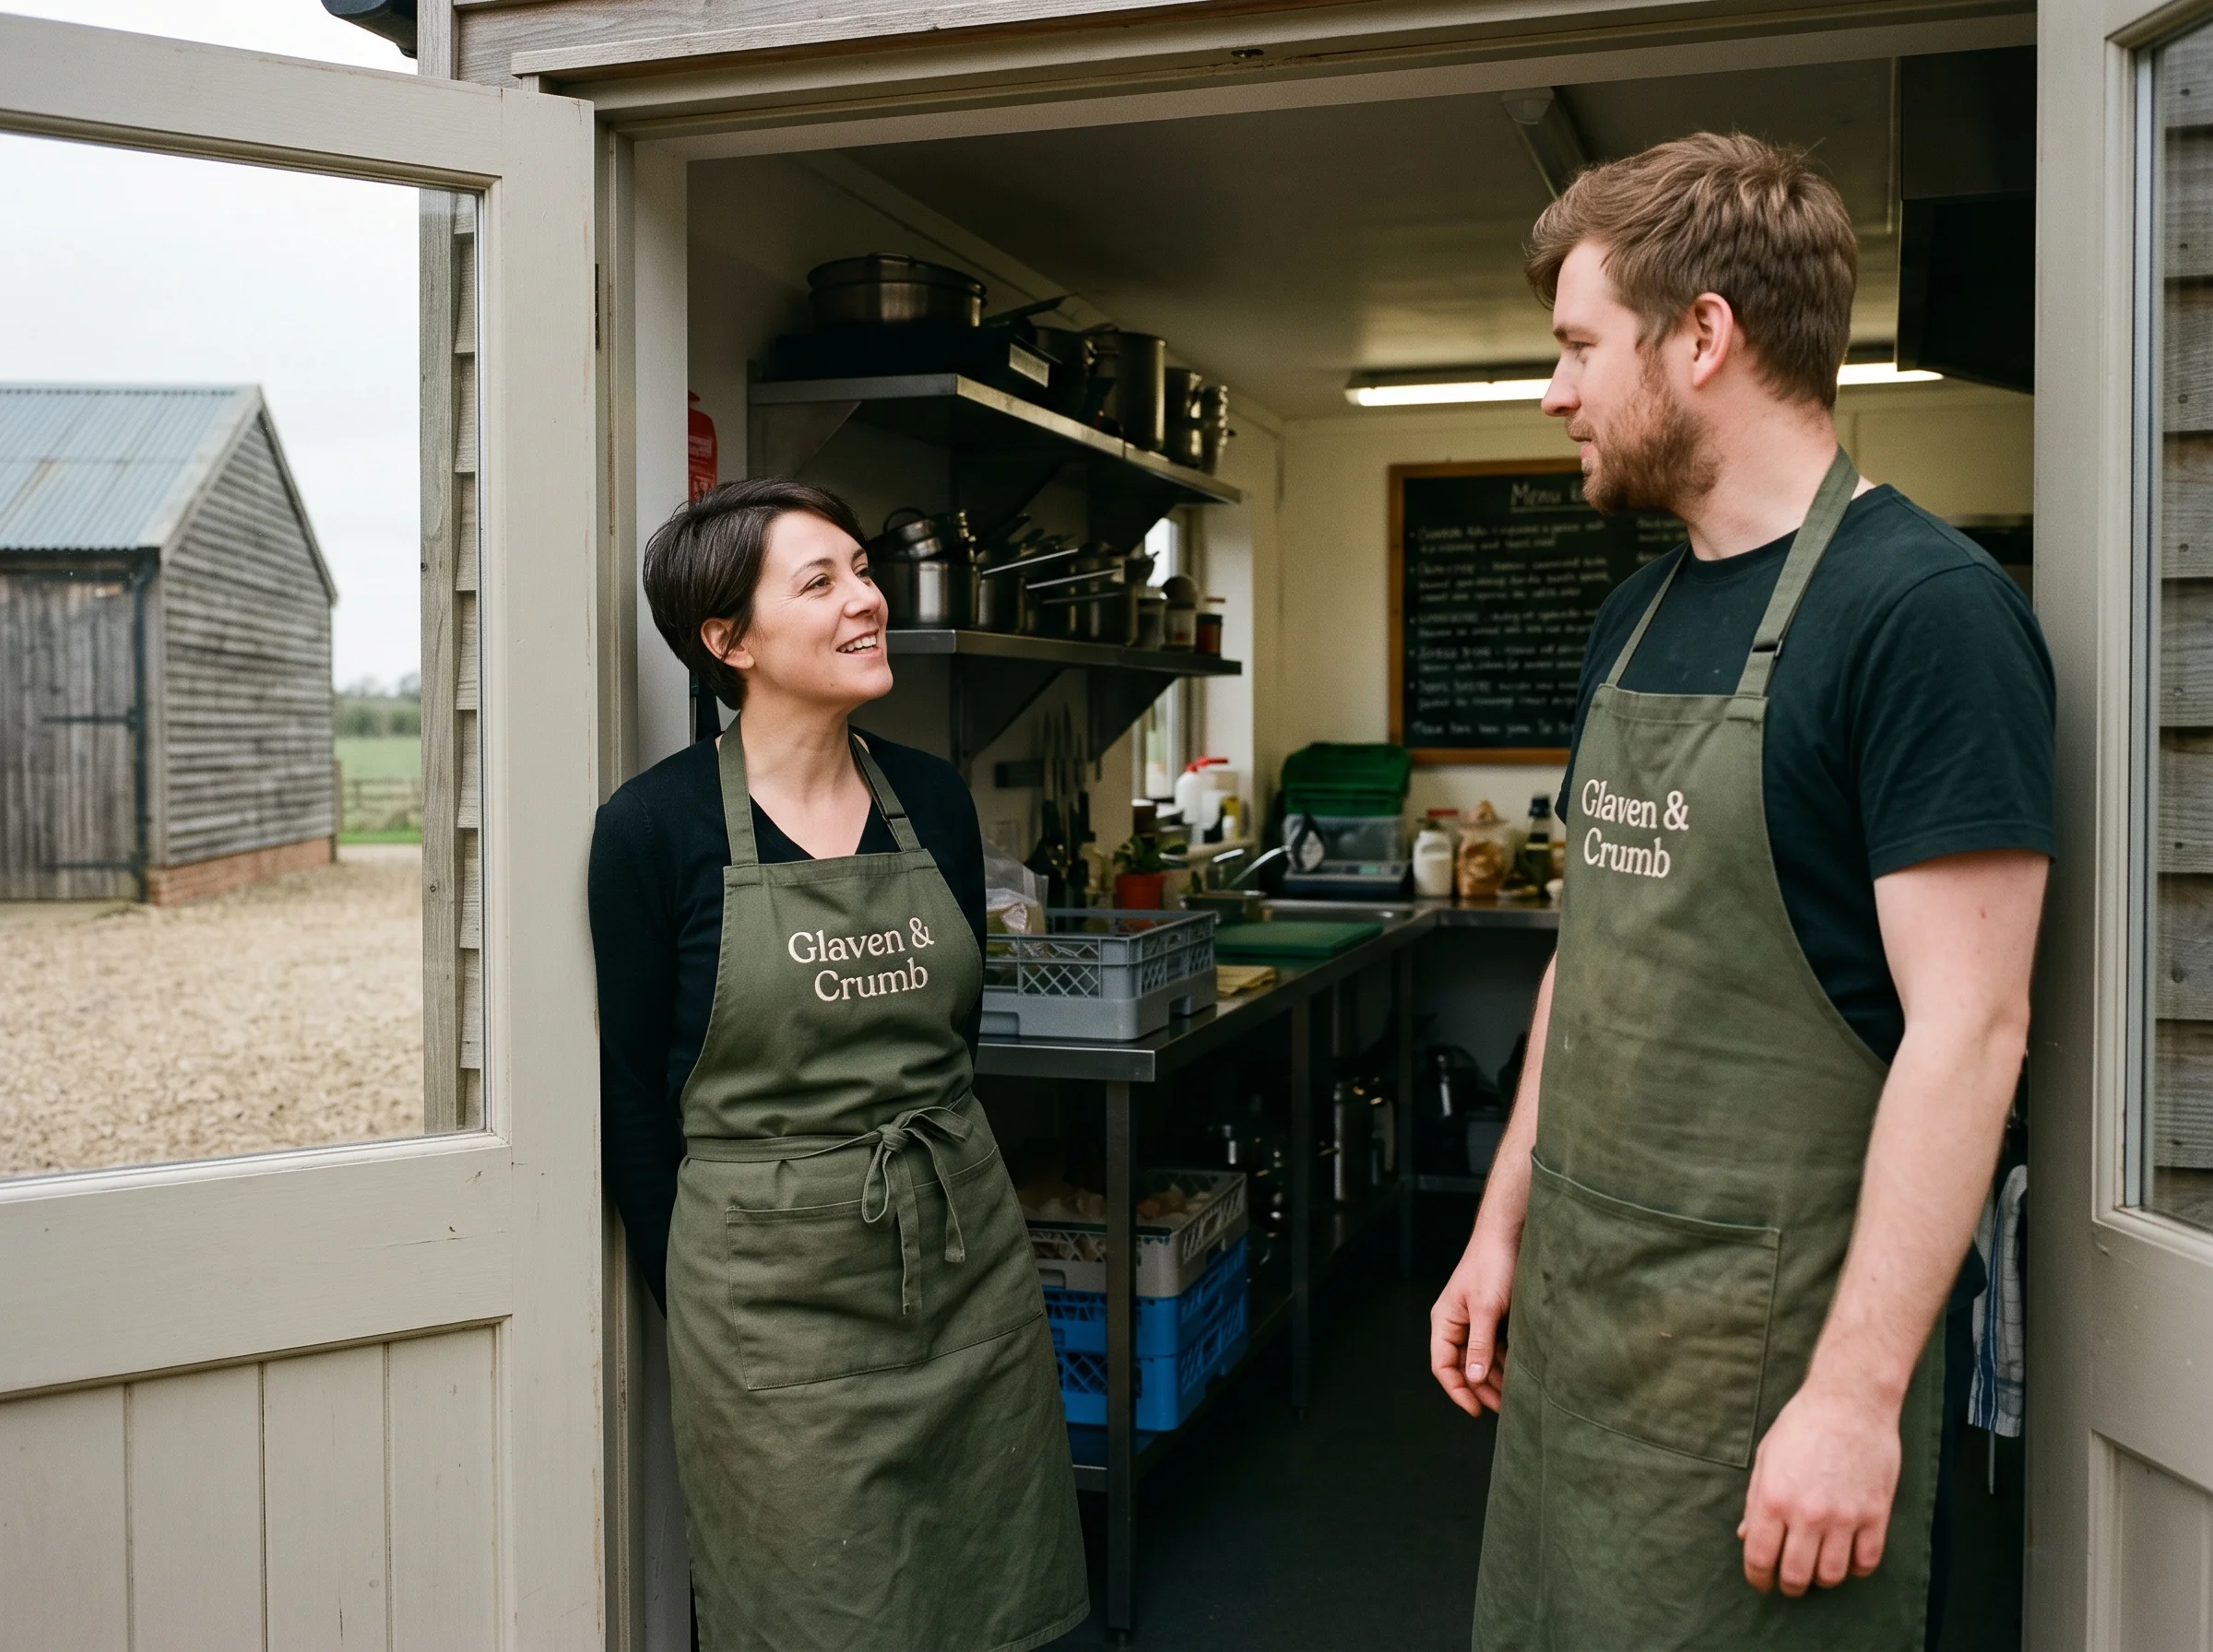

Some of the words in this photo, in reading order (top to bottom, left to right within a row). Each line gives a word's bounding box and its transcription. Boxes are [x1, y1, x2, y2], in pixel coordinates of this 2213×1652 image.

[1510, 481, 1562, 506] Menu
[1581, 779, 1658, 829] Glaven
[1663, 790, 1689, 831] &
[1583, 827, 1671, 879] Crumb
[787, 929, 906, 964] Glaven
[908, 917, 935, 949] &
[814, 957, 929, 1002] Crumb
